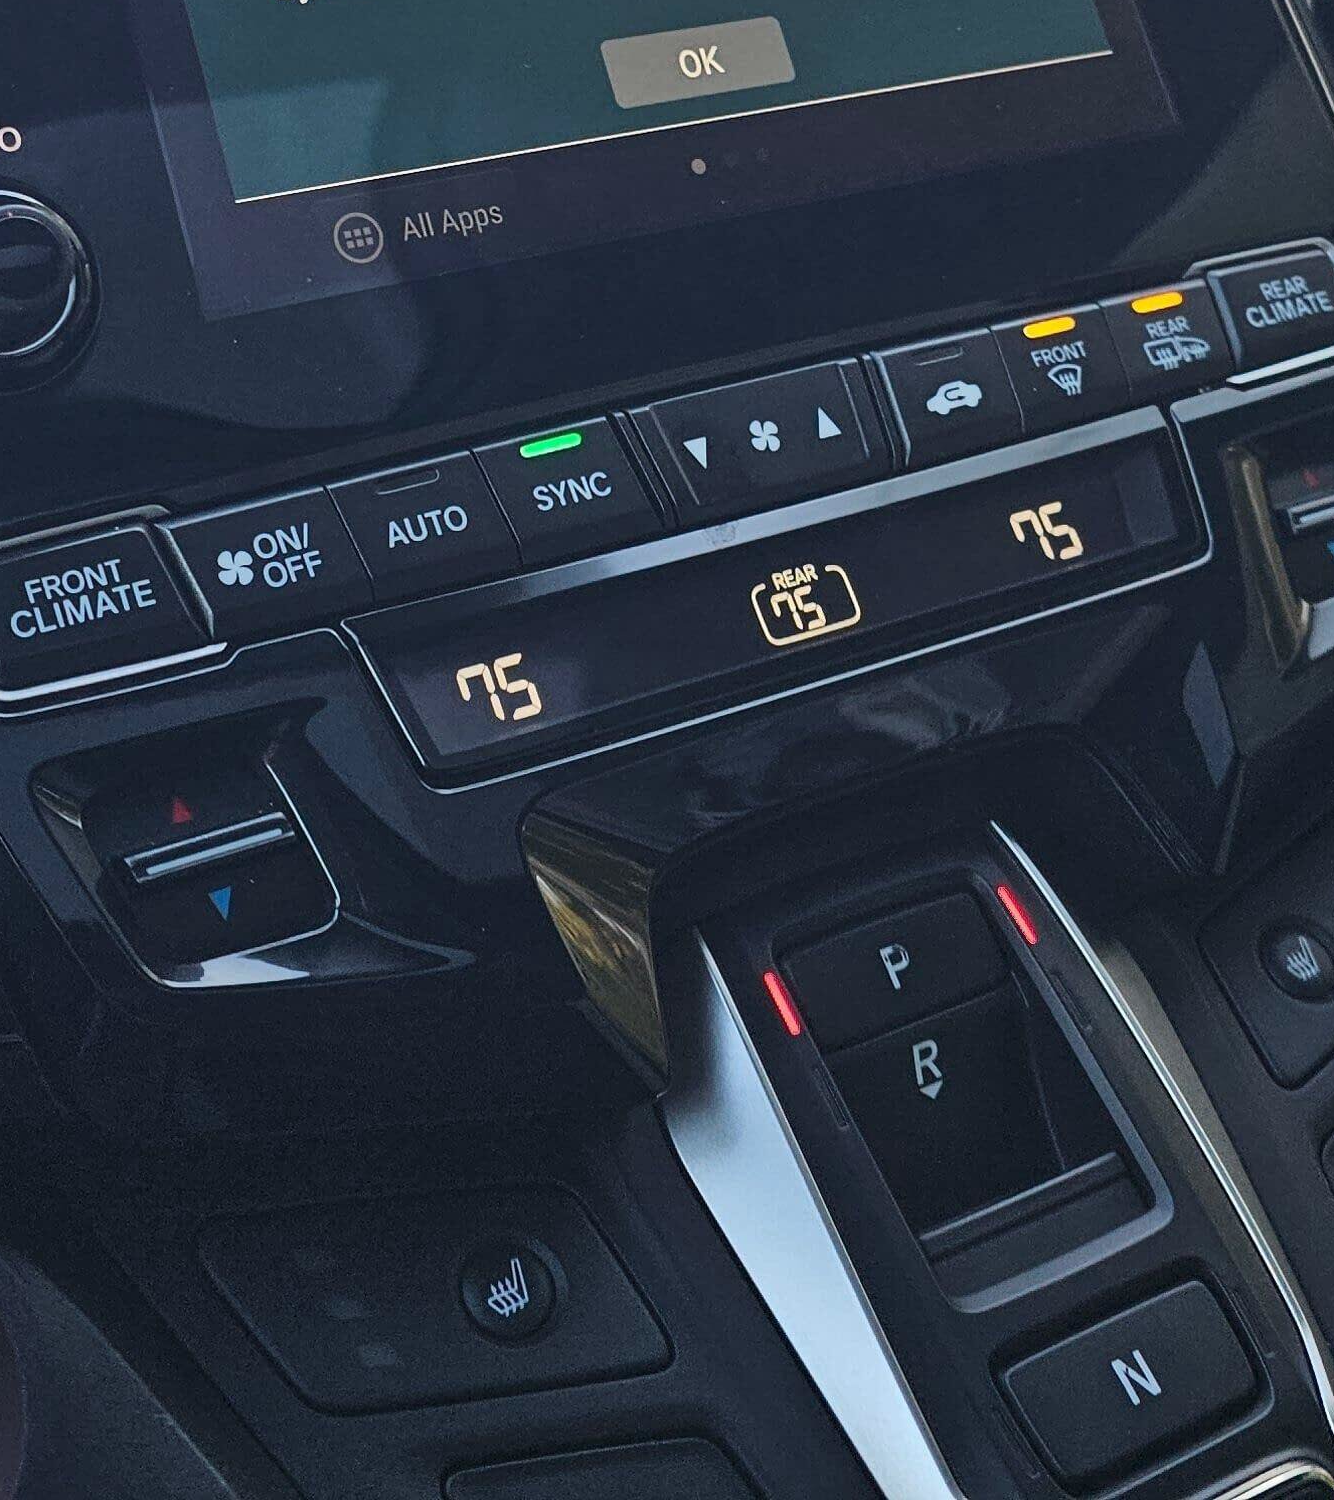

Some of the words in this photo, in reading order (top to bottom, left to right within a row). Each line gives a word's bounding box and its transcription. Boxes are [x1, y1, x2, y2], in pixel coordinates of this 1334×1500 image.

[678, 45, 725, 79] OK
[402, 210, 434, 242] All
[442, 202, 504, 238] Apps
[1259, 274, 1308, 301] REAR
[1145, 315, 1190, 338] REAR
[1245, 290, 1334, 329] CLIMATE
[1030, 339, 1087, 368] FRONT
[532, 471, 612, 513] SYNC
[253, 523, 309, 558] ON/
[387, 505, 468, 548] AUTO
[1009, 501, 1084, 561] 75
[24, 558, 122, 604] FRONT
[266, 550, 322, 588] OFF
[771, 563, 818, 591] REAR
[9, 579, 157, 639] CLIMATE
[769, 585, 827, 631] 75
[456, 652, 542, 722] 75
[879, 942, 910, 990] P
[912, 1039, 942, 1087] R
[1111, 1349, 1163, 1406] N
